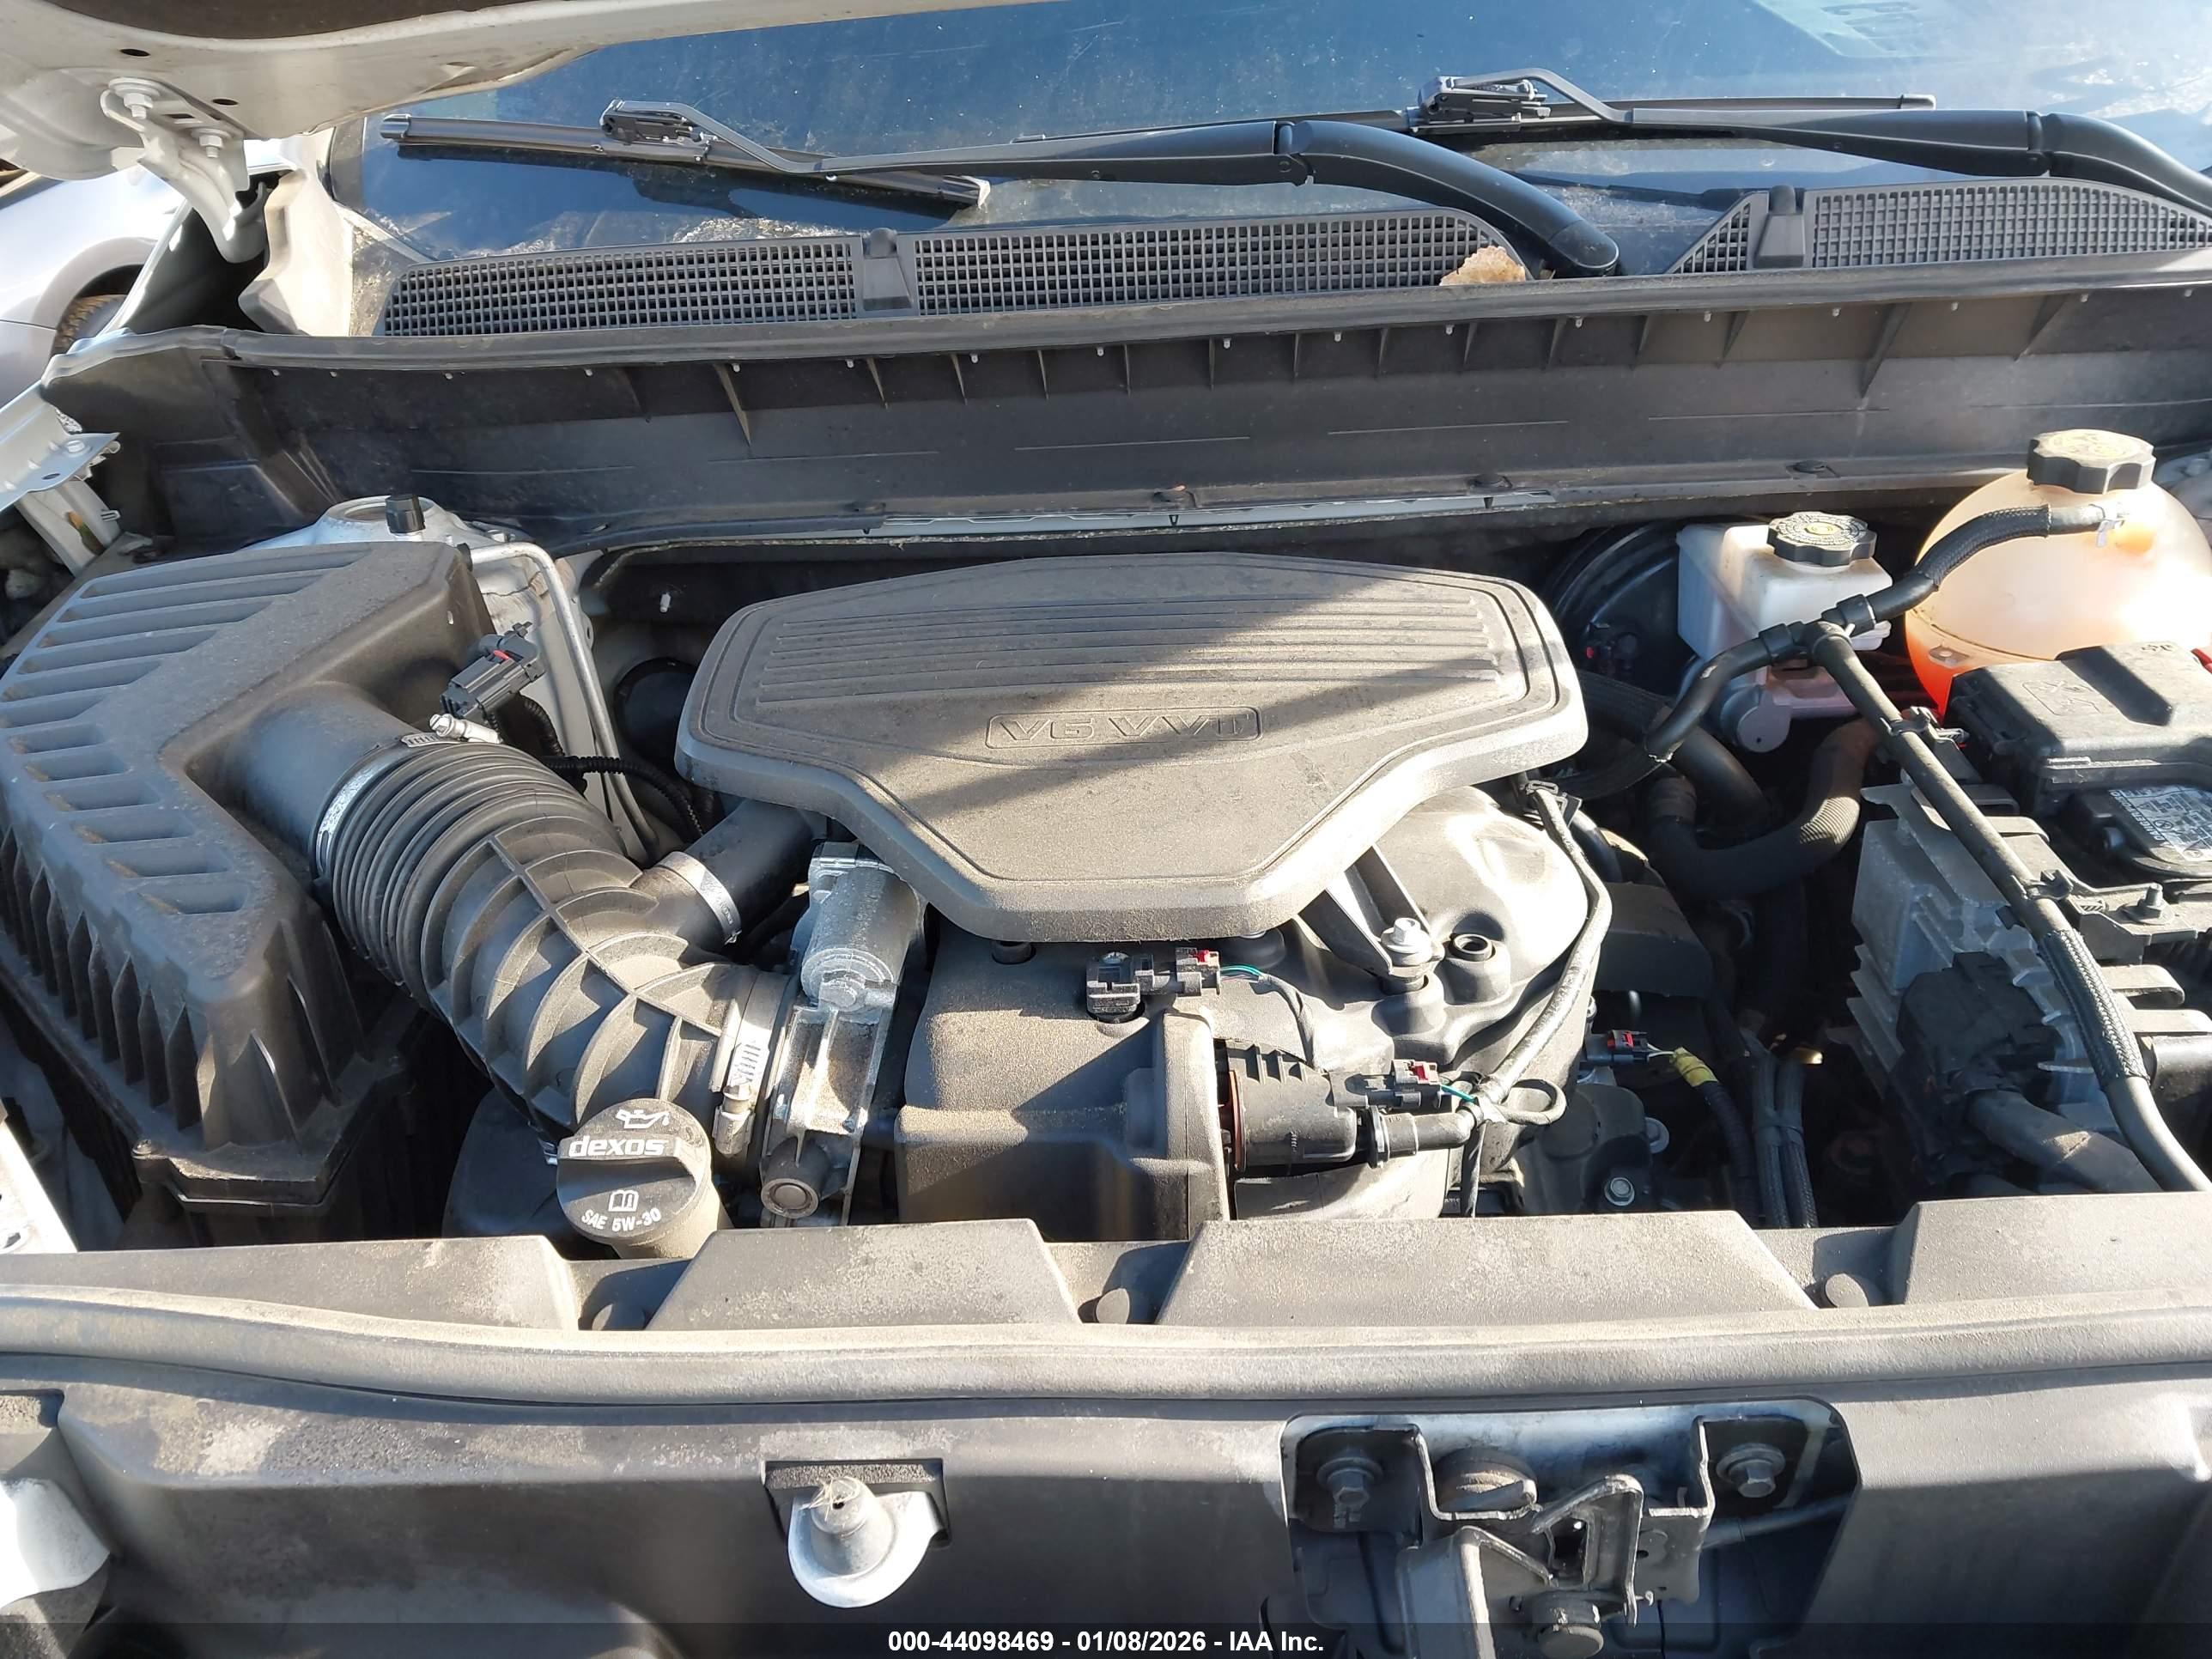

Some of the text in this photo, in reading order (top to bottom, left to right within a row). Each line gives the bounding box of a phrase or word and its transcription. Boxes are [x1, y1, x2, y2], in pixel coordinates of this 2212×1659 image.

[999, 713, 1251, 741] V6 VVT
[568, 1135, 668, 1157] dexos
[581, 1208, 661, 1231] SAE 5W-30
